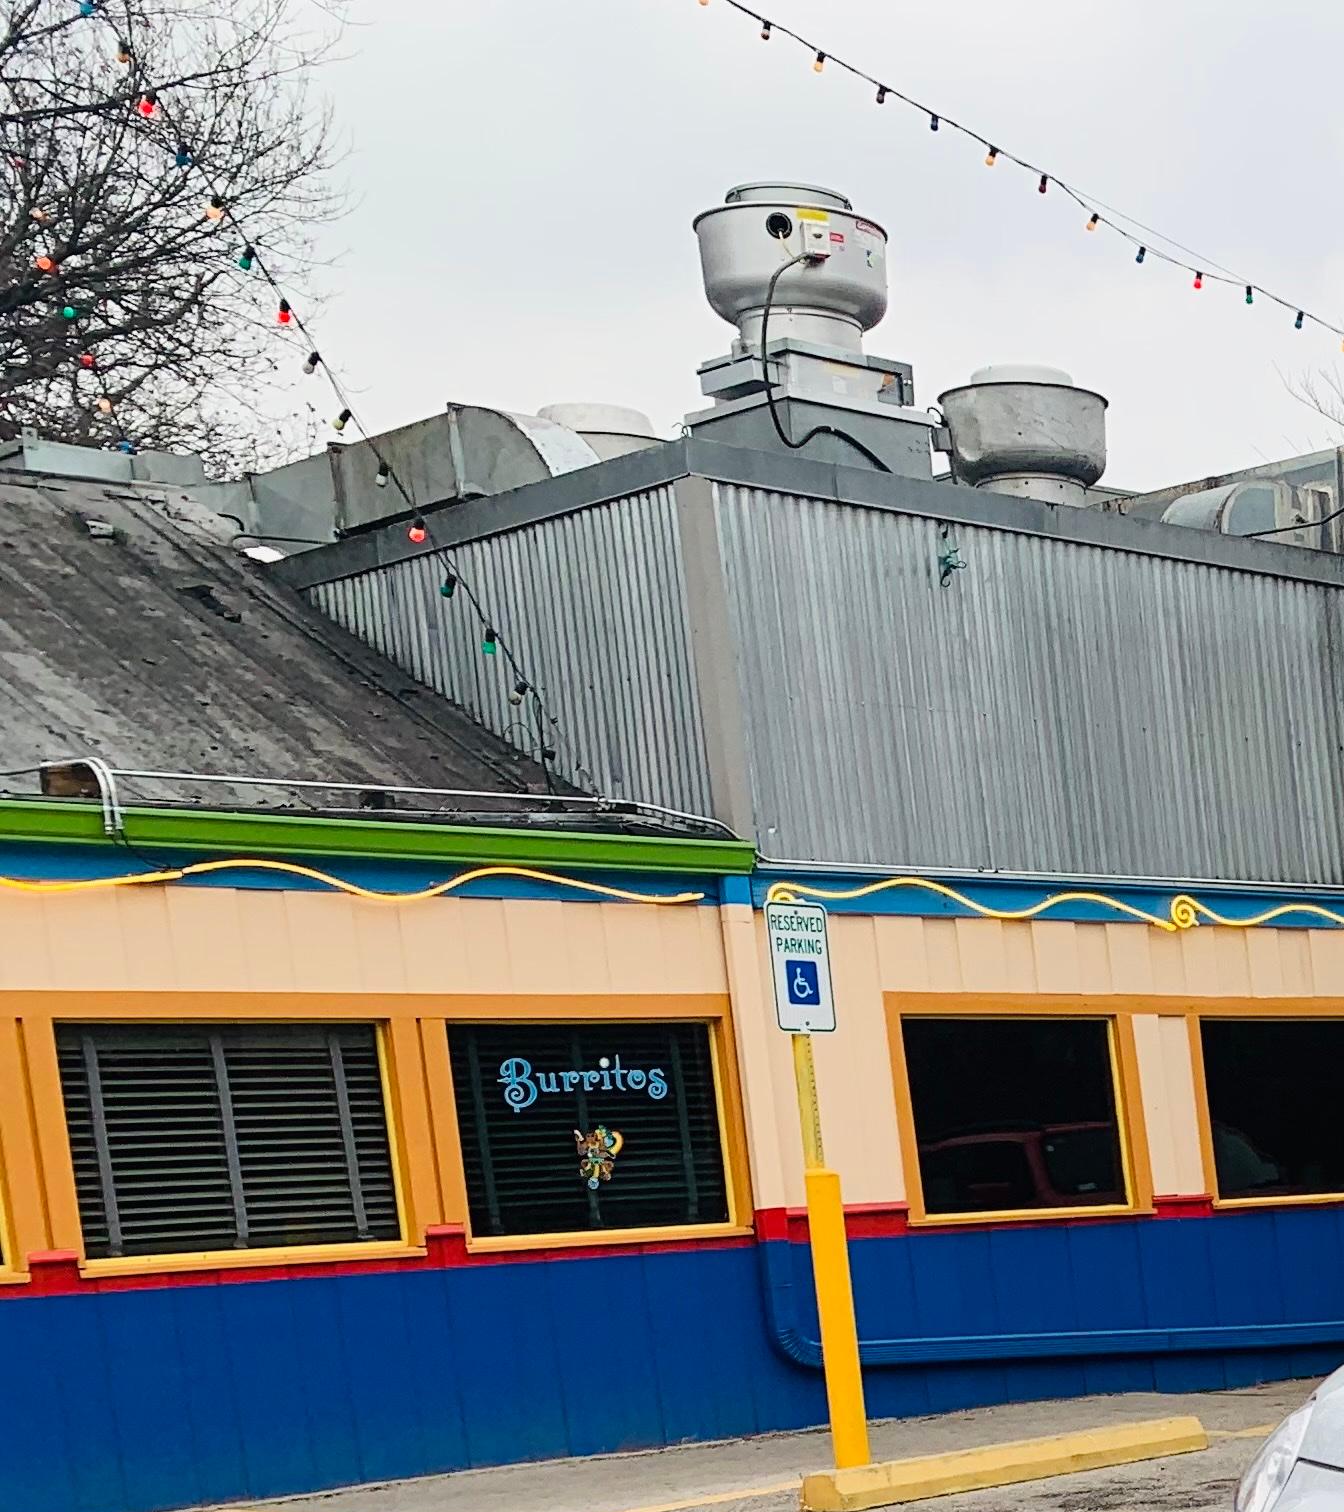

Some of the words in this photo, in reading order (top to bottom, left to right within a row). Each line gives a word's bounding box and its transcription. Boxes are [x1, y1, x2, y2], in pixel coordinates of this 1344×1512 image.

[769, 913, 824, 933] RESERVED
[775, 936, 823, 955] PARKING
[496, 1053, 669, 1113] Burritos
